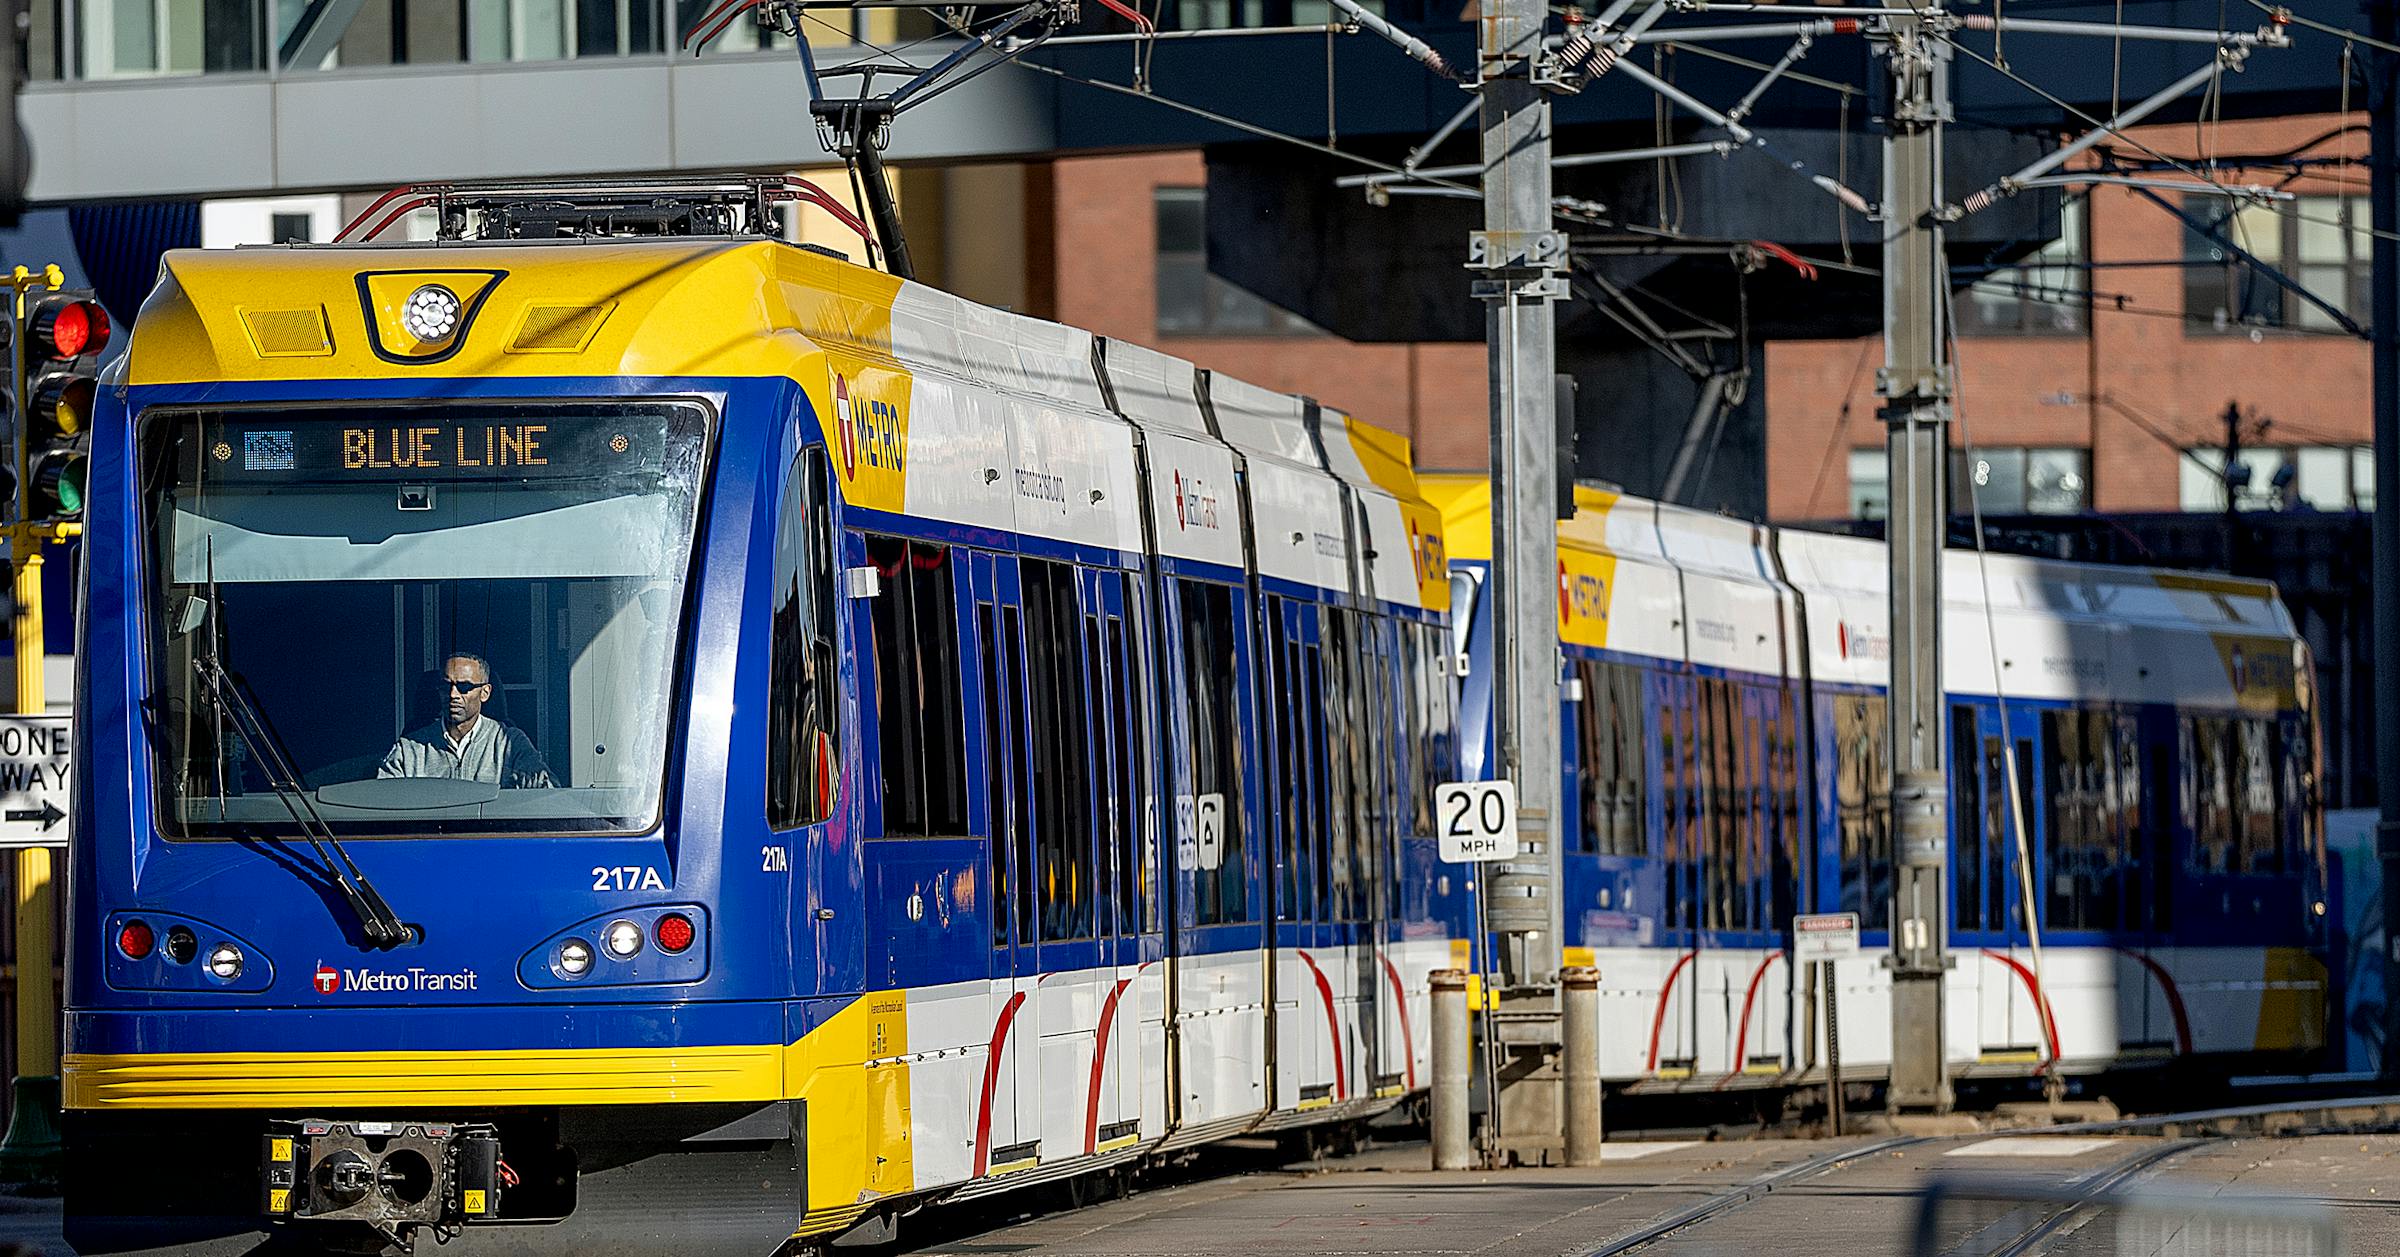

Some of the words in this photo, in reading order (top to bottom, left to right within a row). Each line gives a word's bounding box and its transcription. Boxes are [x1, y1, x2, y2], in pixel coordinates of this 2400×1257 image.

[343, 427, 440, 469] BLUE
[457, 425, 548, 467] LINE
[853, 396, 902, 473] METRO
[4, 727, 69, 756] ONE
[0, 763, 69, 791] WAY
[1447, 789, 1505, 836] 20
[762, 846, 787, 872] 217A
[1461, 841, 1495, 853] MPH
[592, 867, 665, 891] 217A
[344, 968, 477, 992] MetroTransit
